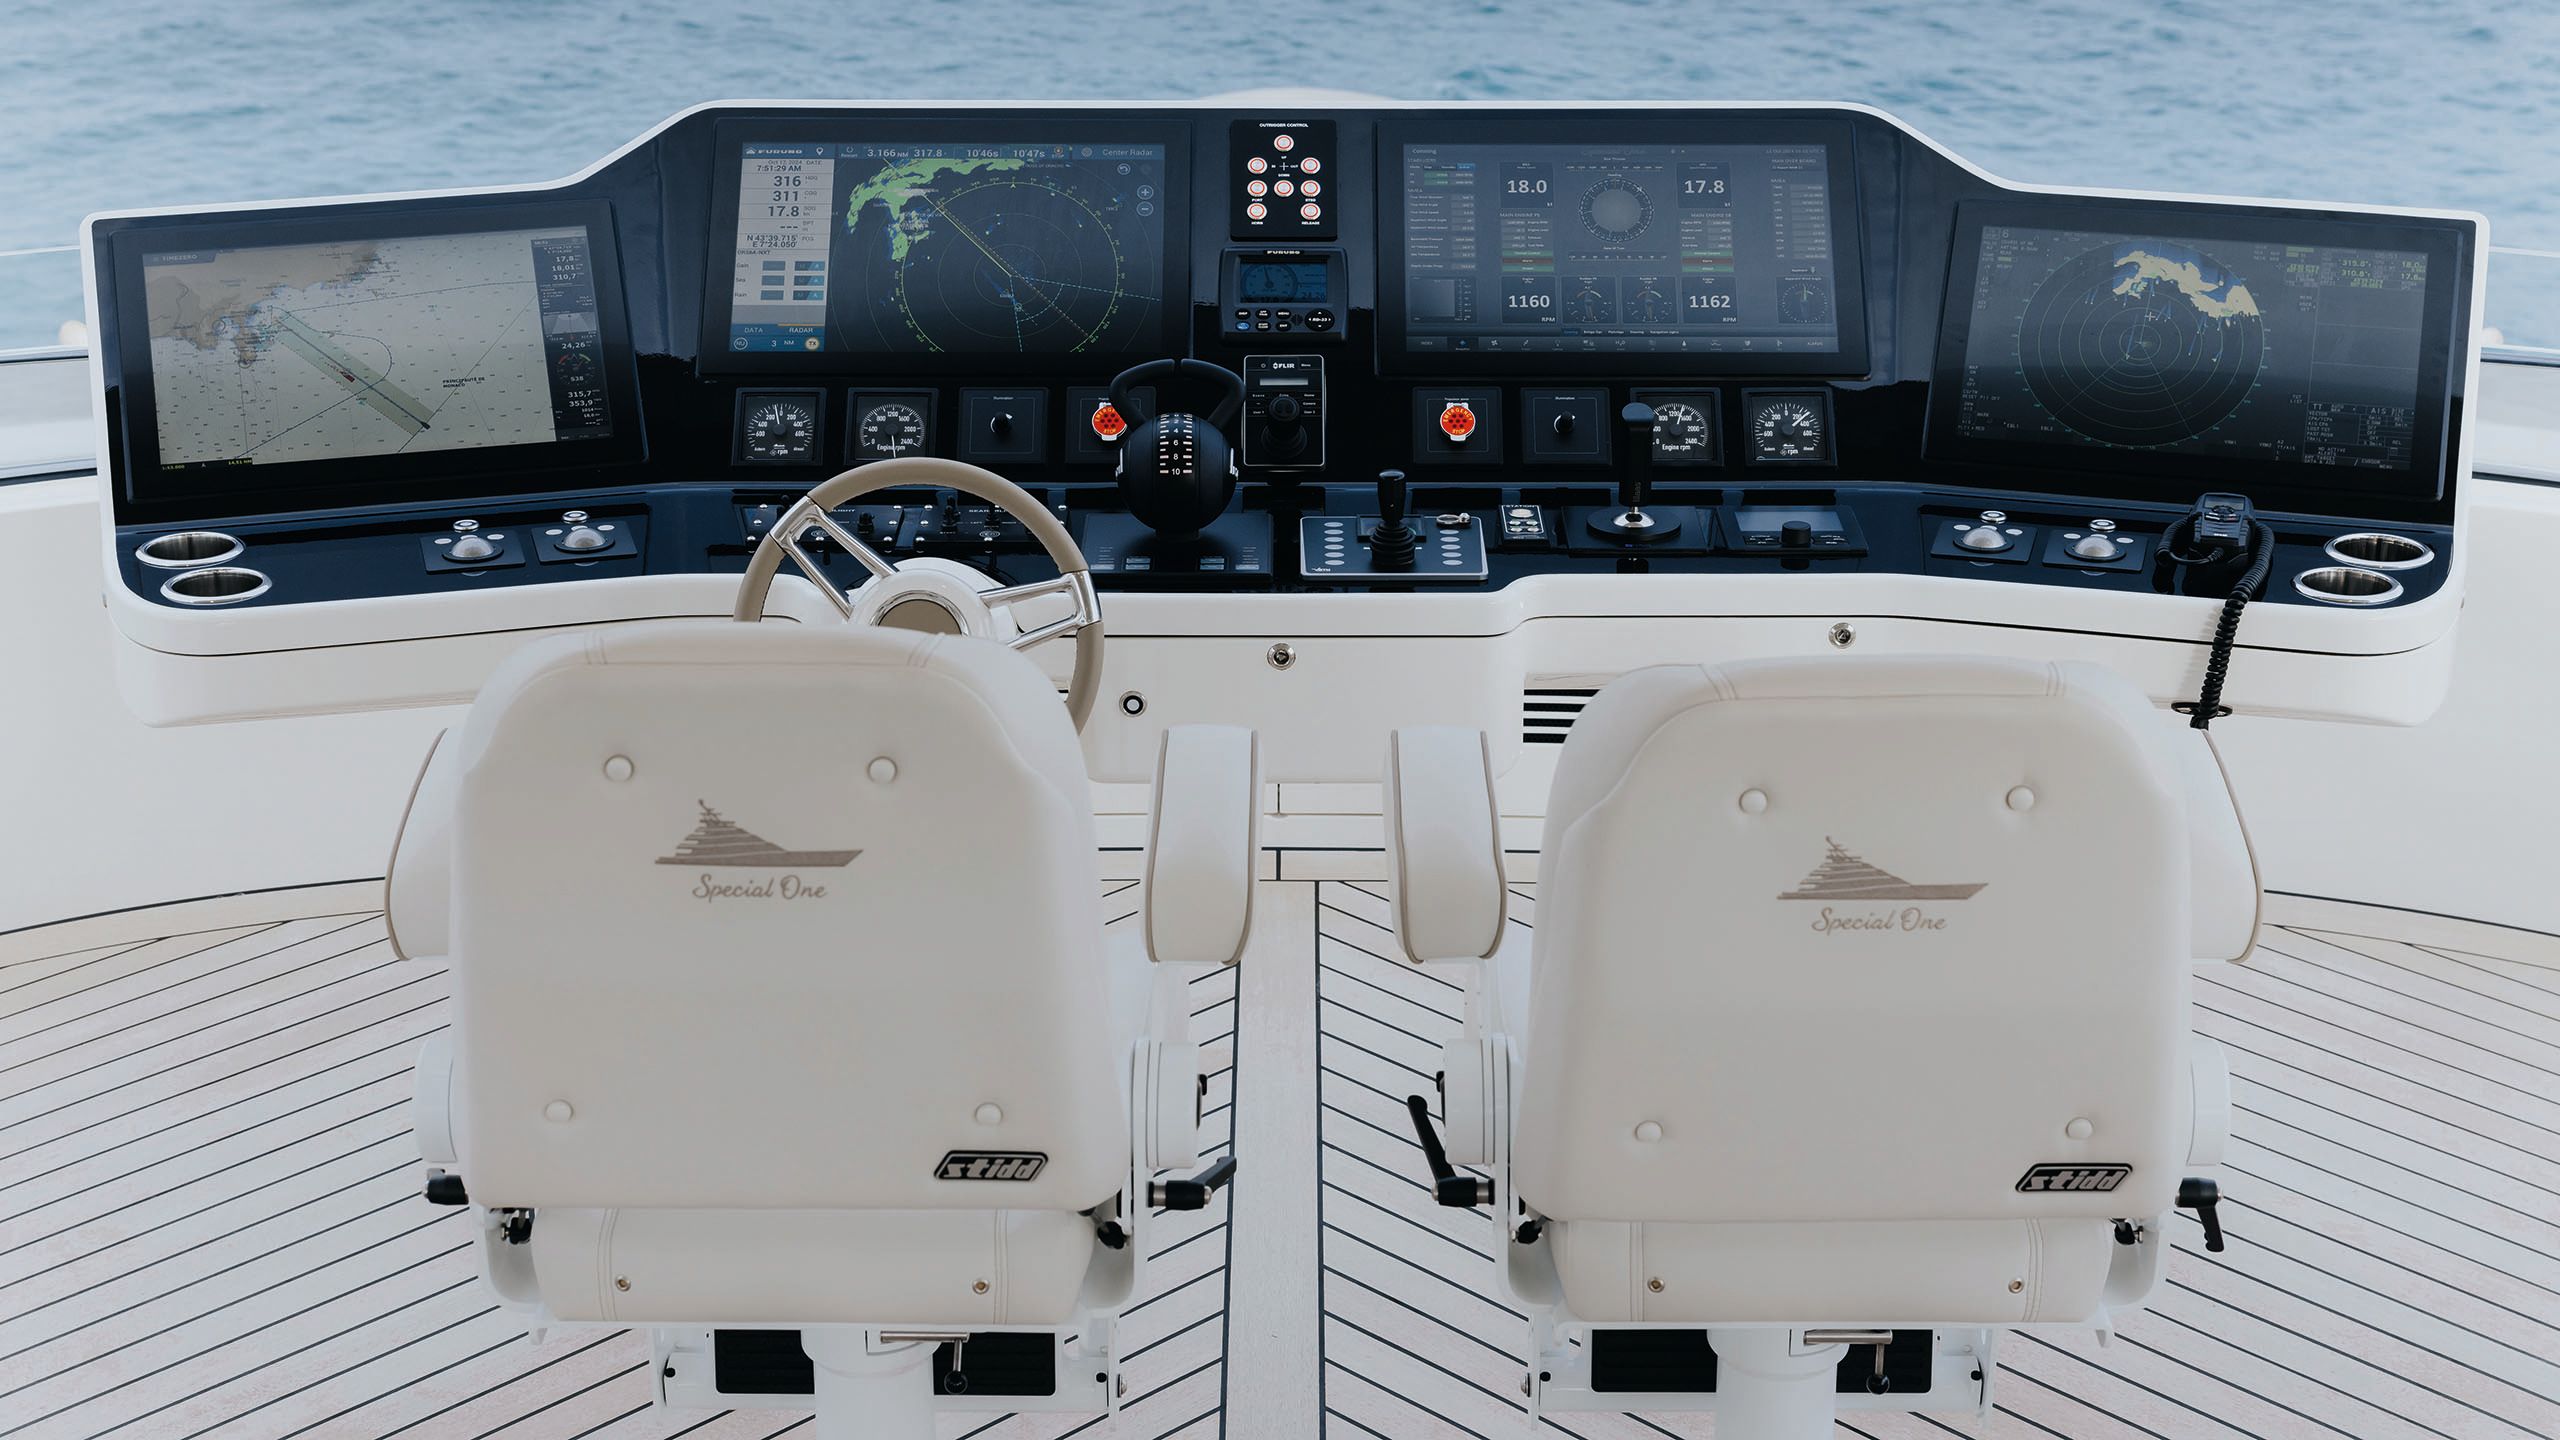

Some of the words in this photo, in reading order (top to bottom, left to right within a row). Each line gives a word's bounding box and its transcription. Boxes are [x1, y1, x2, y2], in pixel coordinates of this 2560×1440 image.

[867, 149, 896, 157] 3.166
[914, 149, 943, 157] 317.8
[774, 175, 802, 187] 316
[1507, 179, 1547, 194] 18.0
[1684, 180, 1725, 194] 17.8
[773, 190, 799, 202] 311
[768, 205, 800, 217] 17.8
[1508, 295, 1550, 308] 1160
[1689, 295, 1731, 308] 1162
[771, 339, 777, 347] 3
[568, 390, 592, 398] 315,7
[1443, 408, 1473, 423] EMERGENCY
[2370, 407, 2387, 415] AIS
[1662, 443, 1679, 452] Engine
[1173, 453, 1179, 461] 8
[1171, 467, 1181, 476] 10
[692, 873, 774, 903] Special
[780, 875, 827, 900] One
[1811, 907, 1897, 936] Special
[1900, 907, 1947, 932] One
[943, 1158, 1042, 1179] stidd
[2025, 1170, 2127, 1190] stidd
